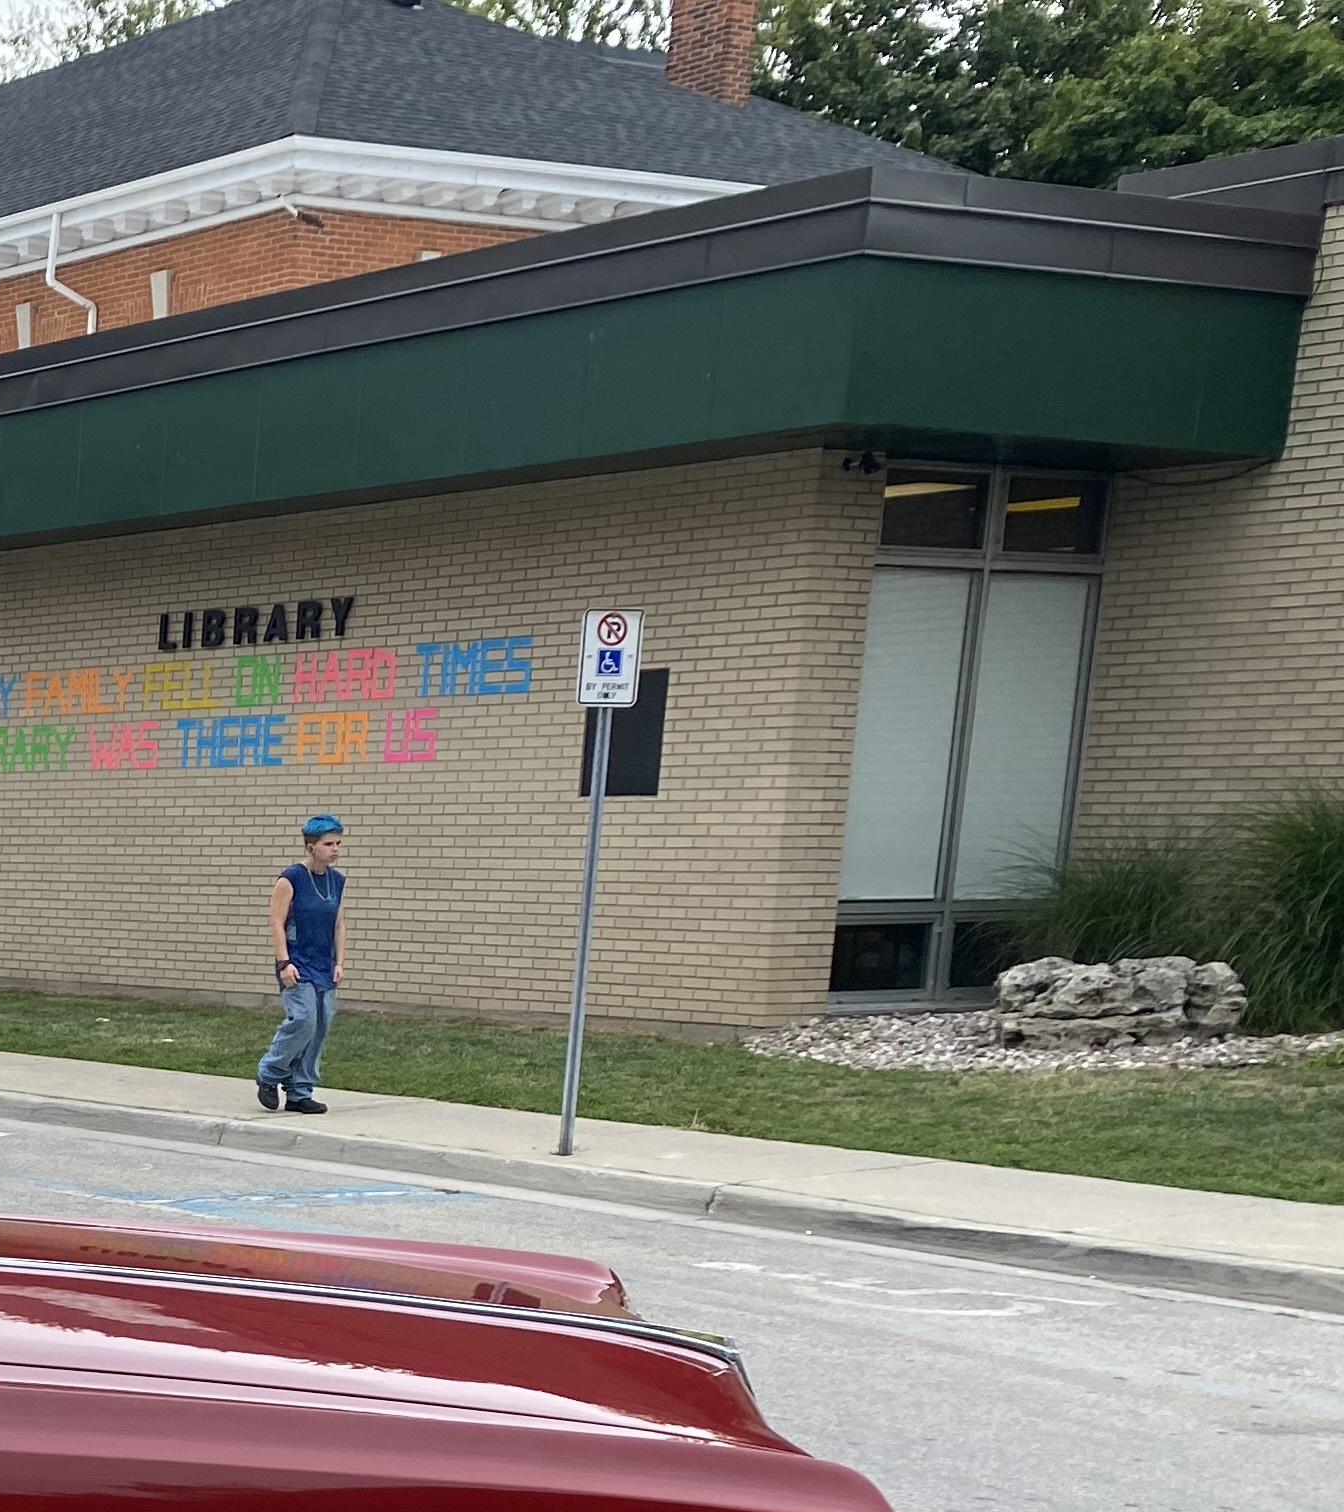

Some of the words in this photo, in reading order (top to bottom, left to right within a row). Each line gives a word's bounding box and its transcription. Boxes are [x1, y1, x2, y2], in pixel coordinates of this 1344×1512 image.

[158, 597, 354, 650] LIBRARY
[23, 665, 135, 716] FAMILY
[143, 660, 221, 711] FELL
[235, 654, 282, 706] ON
[293, 648, 397, 704] HARD
[416, 636, 535, 697] TIMES
[585, 682, 597, 691] BY
[602, 682, 630, 691] PERMIT
[88, 720, 160, 771] WAS
[177, 714, 285, 767] THERE
[296, 711, 369, 764] FOR
[384, 707, 439, 763] US
